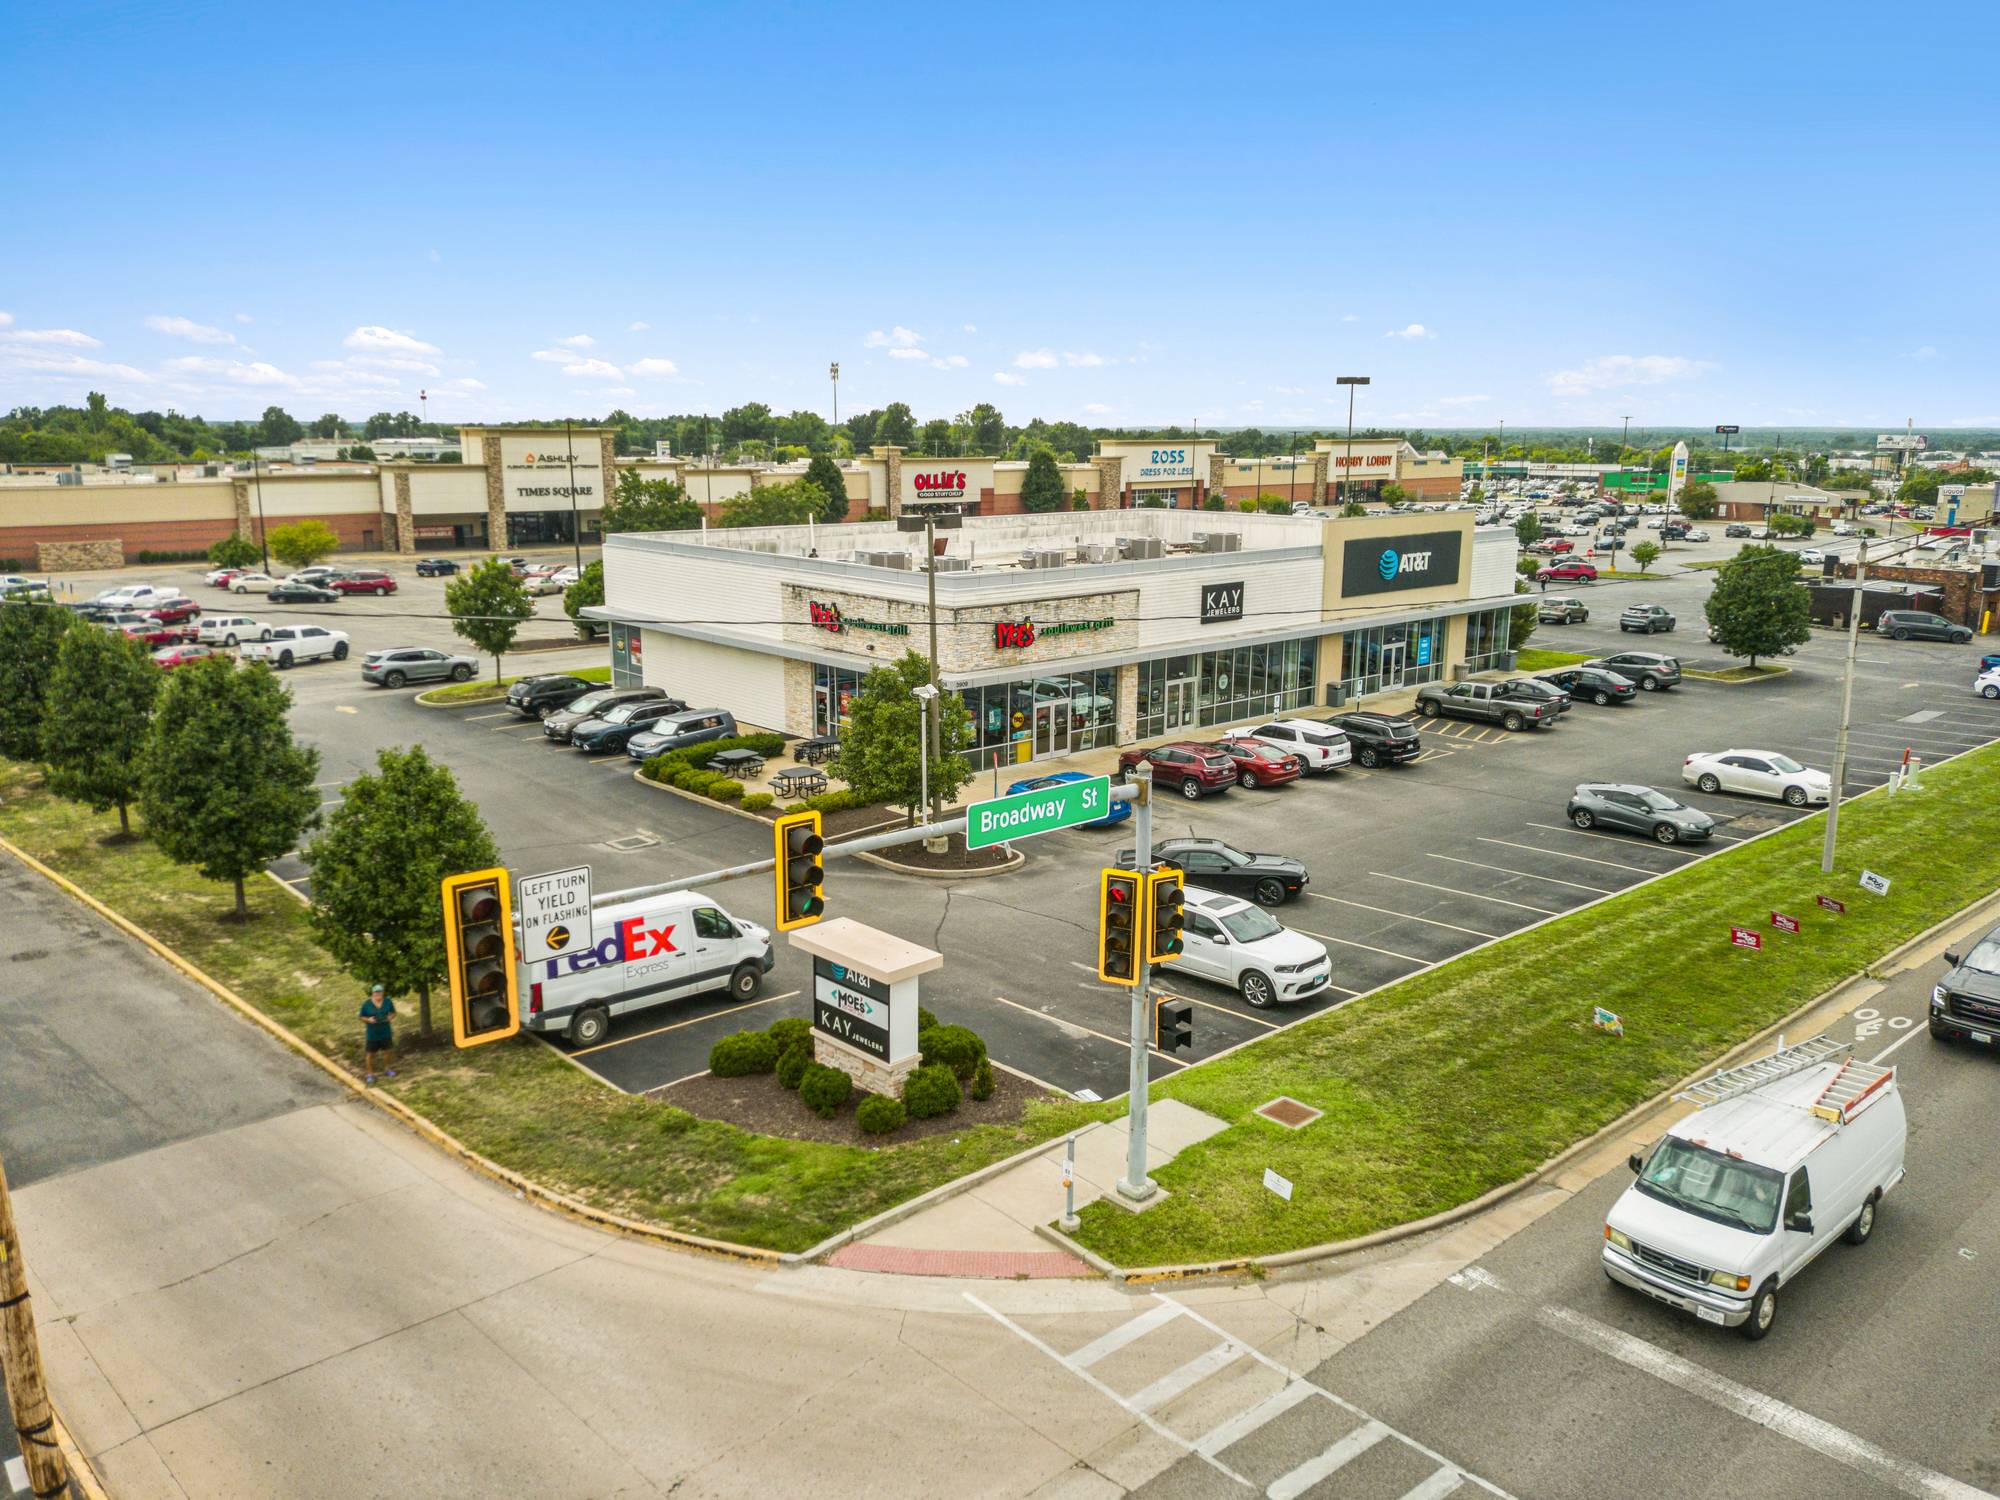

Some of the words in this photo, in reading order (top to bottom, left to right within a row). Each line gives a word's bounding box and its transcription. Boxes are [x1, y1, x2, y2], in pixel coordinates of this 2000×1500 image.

[537, 454, 579, 462] ASHLEY
[1151, 449, 1185, 464] ROSS
[1366, 455, 1392, 467] LOBBY
[914, 470, 966, 491] OLLIE'S
[1163, 467, 1176, 475] FOR
[517, 487, 550, 497] TIMES
[552, 487, 592, 497] SQUARE
[1399, 551, 1431, 573] AT&T
[1206, 589, 1240, 609] KAY
[1206, 606, 1240, 617] JEWELERS
[981, 799, 1066, 832] Broadway
[1081, 787, 1098, 809] St
[524, 880, 550, 896] LEFT
[557, 874, 585, 889] TURN
[538, 891, 575, 910] YIELD
[526, 916, 539, 928] ON
[543, 905, 588, 924] FLASHING
[627, 960, 669, 978] Express
[821, 1009, 851, 1036] KAY
[852, 1033, 884, 1053] JEWELERS
